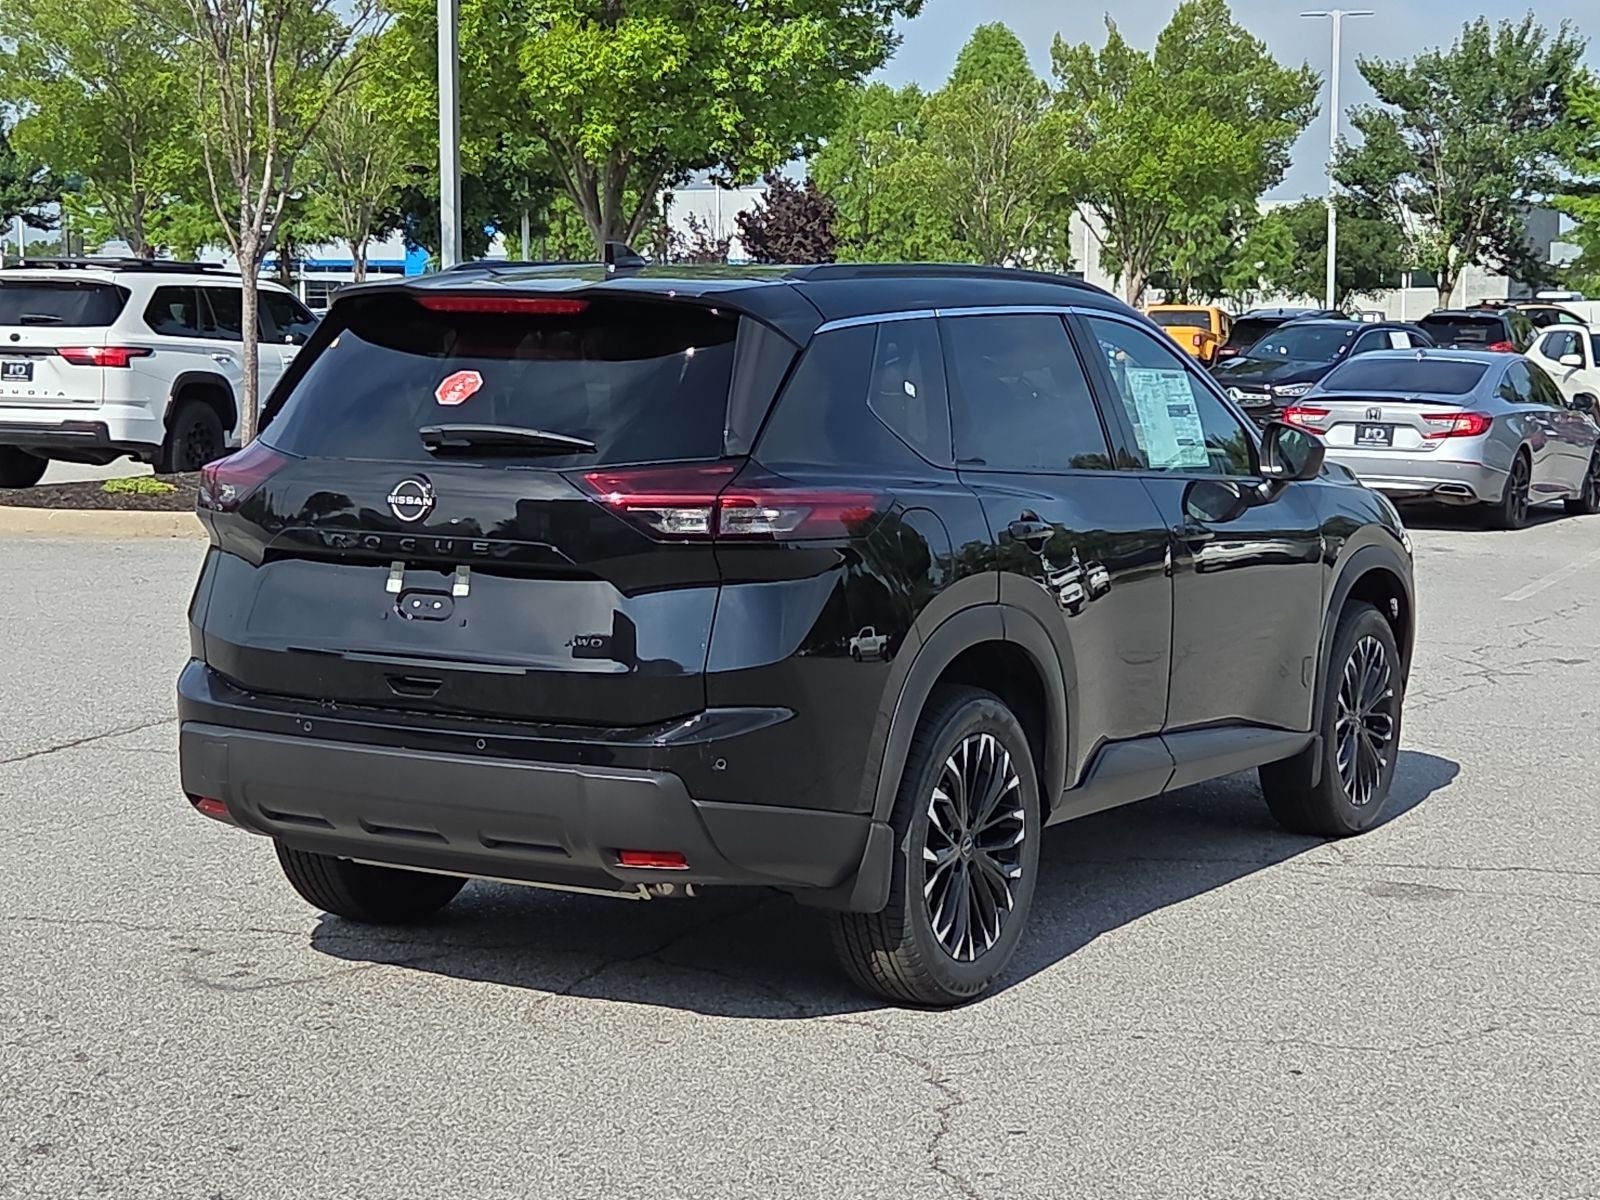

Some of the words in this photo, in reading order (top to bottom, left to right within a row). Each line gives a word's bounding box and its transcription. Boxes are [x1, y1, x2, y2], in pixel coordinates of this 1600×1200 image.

[387, 495, 433, 506] NISSAN
[330, 533, 489, 555] ROGUE
[564, 637, 603, 648] AWD
